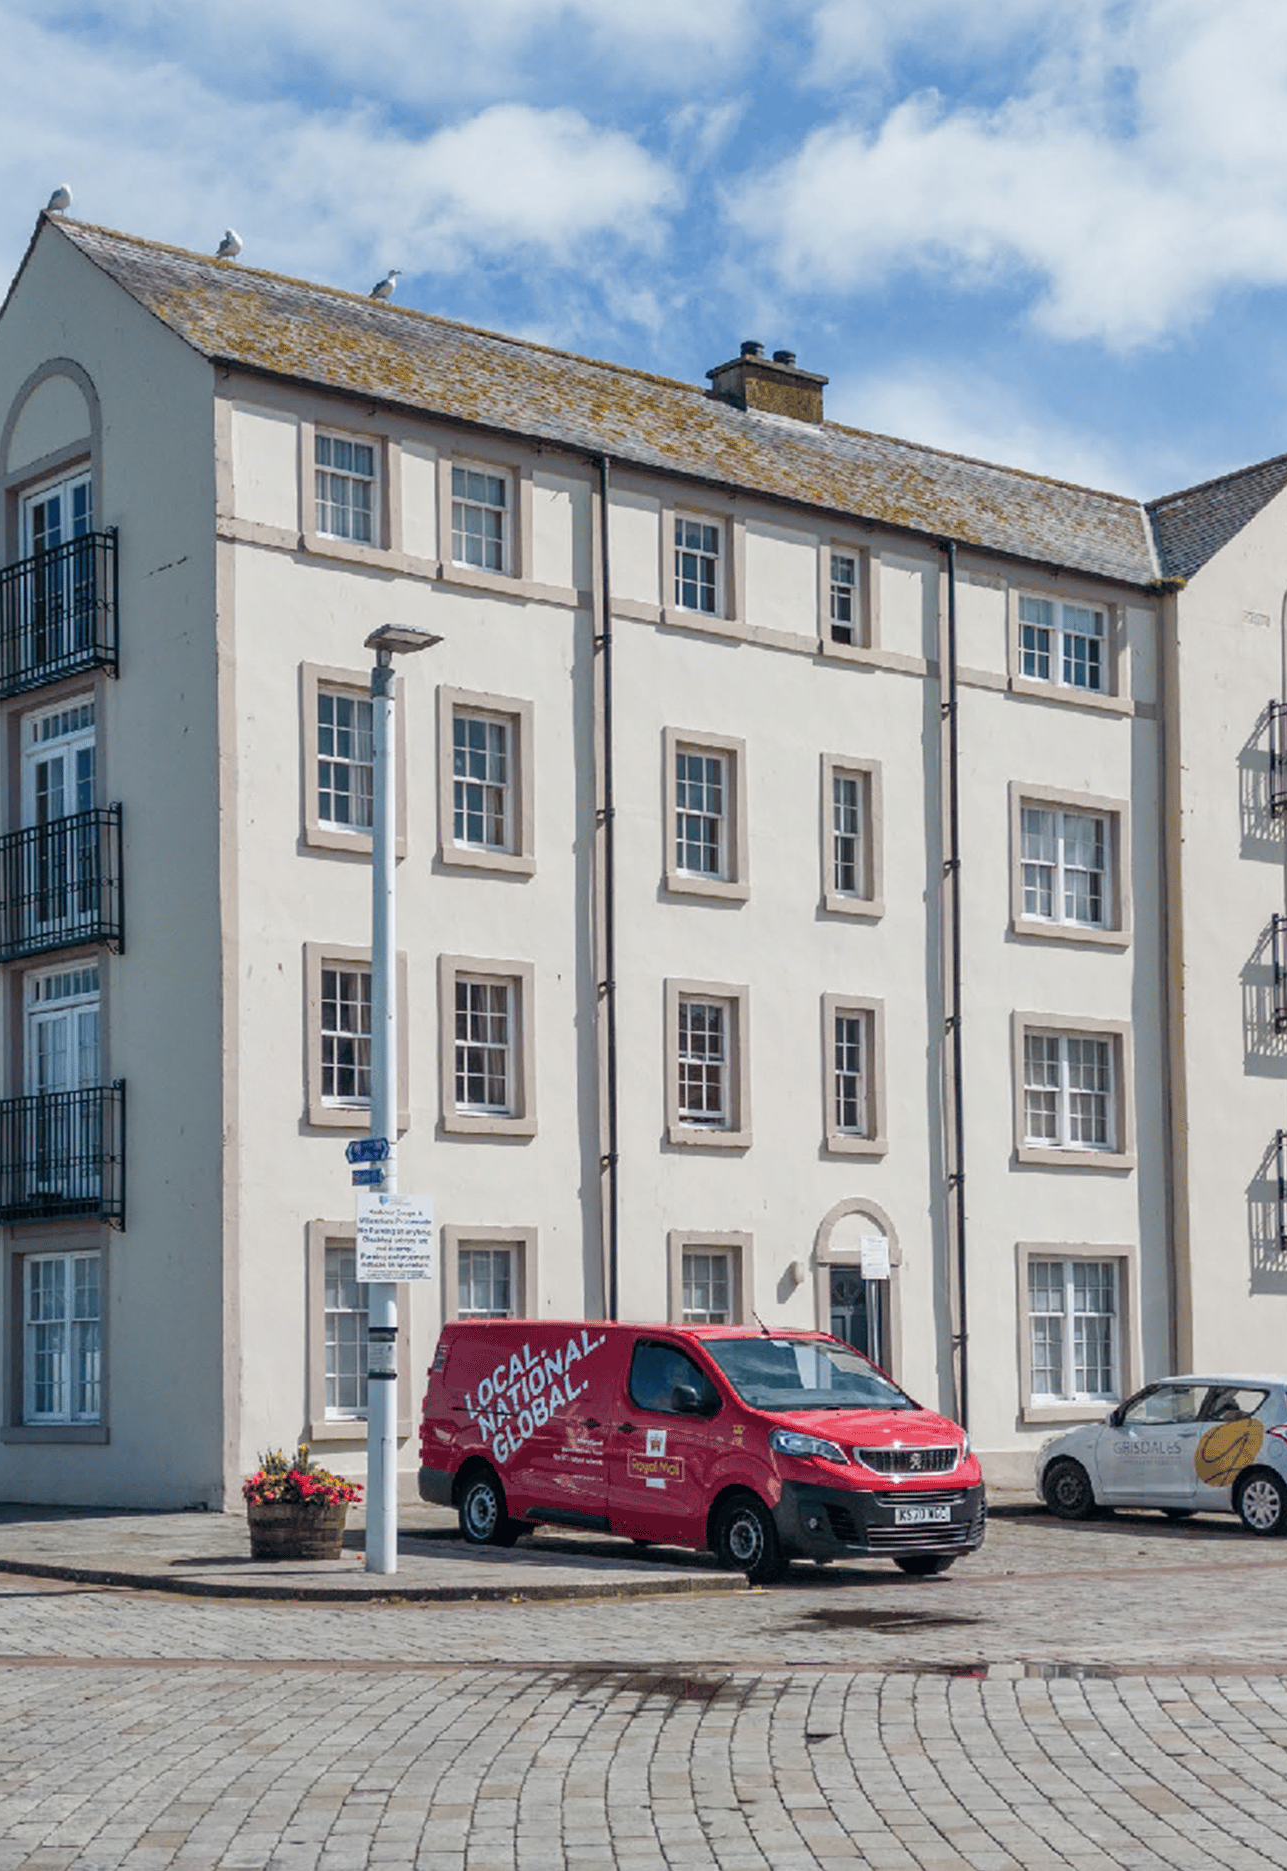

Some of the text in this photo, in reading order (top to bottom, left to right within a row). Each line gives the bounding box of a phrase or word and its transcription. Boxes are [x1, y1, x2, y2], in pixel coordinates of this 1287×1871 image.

[464, 1342, 547, 1419] LOCAL.
[478, 1329, 606, 1442] NATIONAL.
[493, 1373, 589, 1463] GLOBAL.
[631, 1457, 680, 1476] Royal Mail
[1113, 1441, 1182, 1454] GRISDALES
